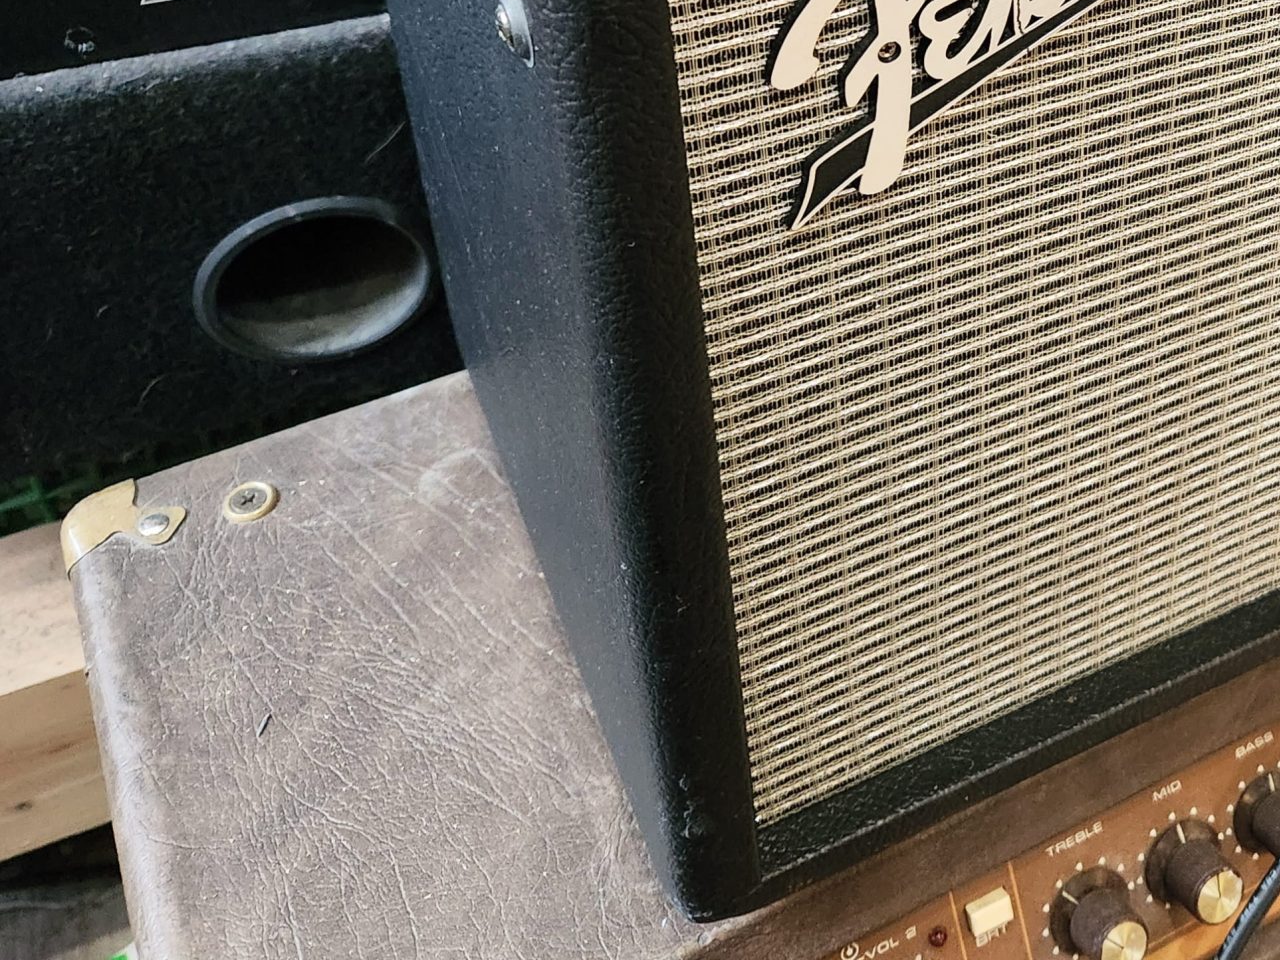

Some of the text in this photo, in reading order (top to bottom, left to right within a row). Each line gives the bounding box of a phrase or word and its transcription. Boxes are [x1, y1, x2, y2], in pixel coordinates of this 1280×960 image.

[1235, 730, 1274, 759] BASS
[1152, 779, 1182, 802] MID
[1045, 821, 1103, 857] TREBLE
[866, 925, 917, 960] VOL 2
